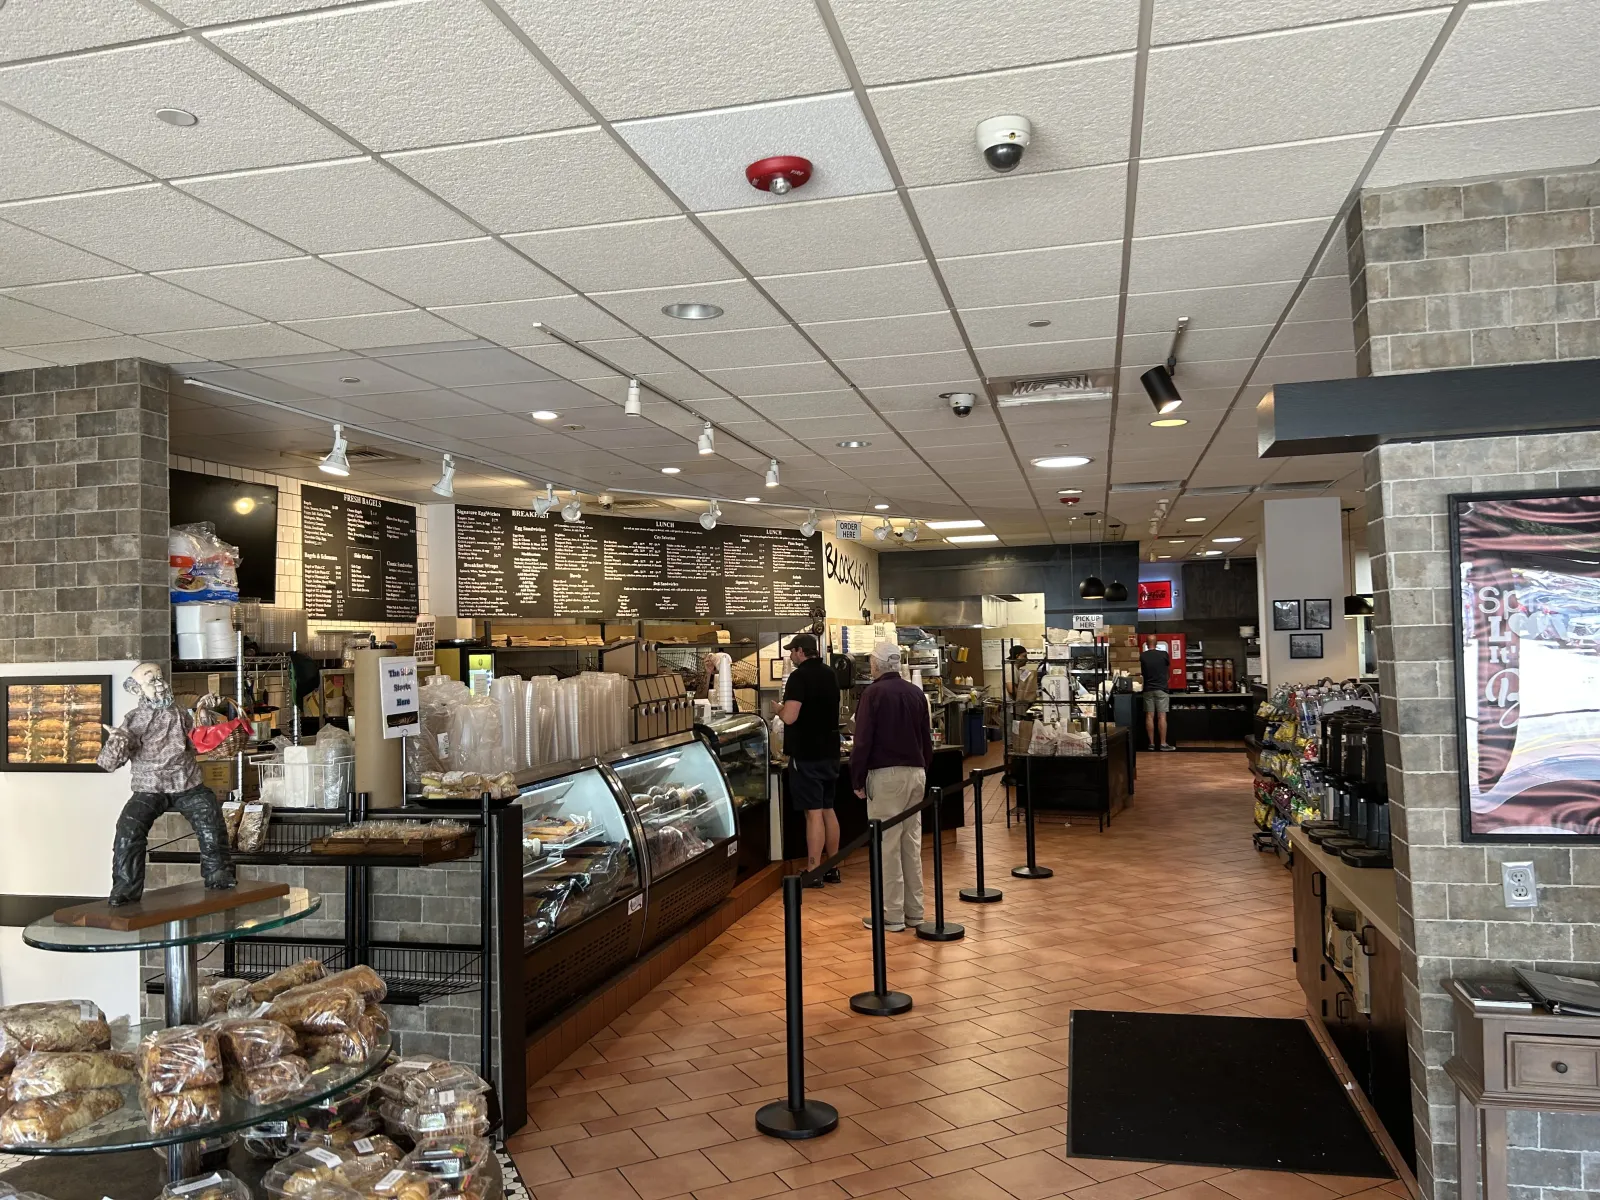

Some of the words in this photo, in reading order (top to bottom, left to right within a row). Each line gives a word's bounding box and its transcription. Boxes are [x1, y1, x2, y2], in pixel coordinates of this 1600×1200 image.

[343, 494, 362, 504] FRESH
[362, 497, 382, 508] BAGELS
[512, 510, 550, 518] BREAKFST
[840, 522, 858, 530] ORDER
[842, 530, 856, 538] HERE
[417, 627, 434, 636] HAPPINESS
[415, 641, 434, 651] BAGELS
[388, 669, 400, 677] The
[394, 684, 411, 692] Starts
[396, 698, 410, 706] Here
